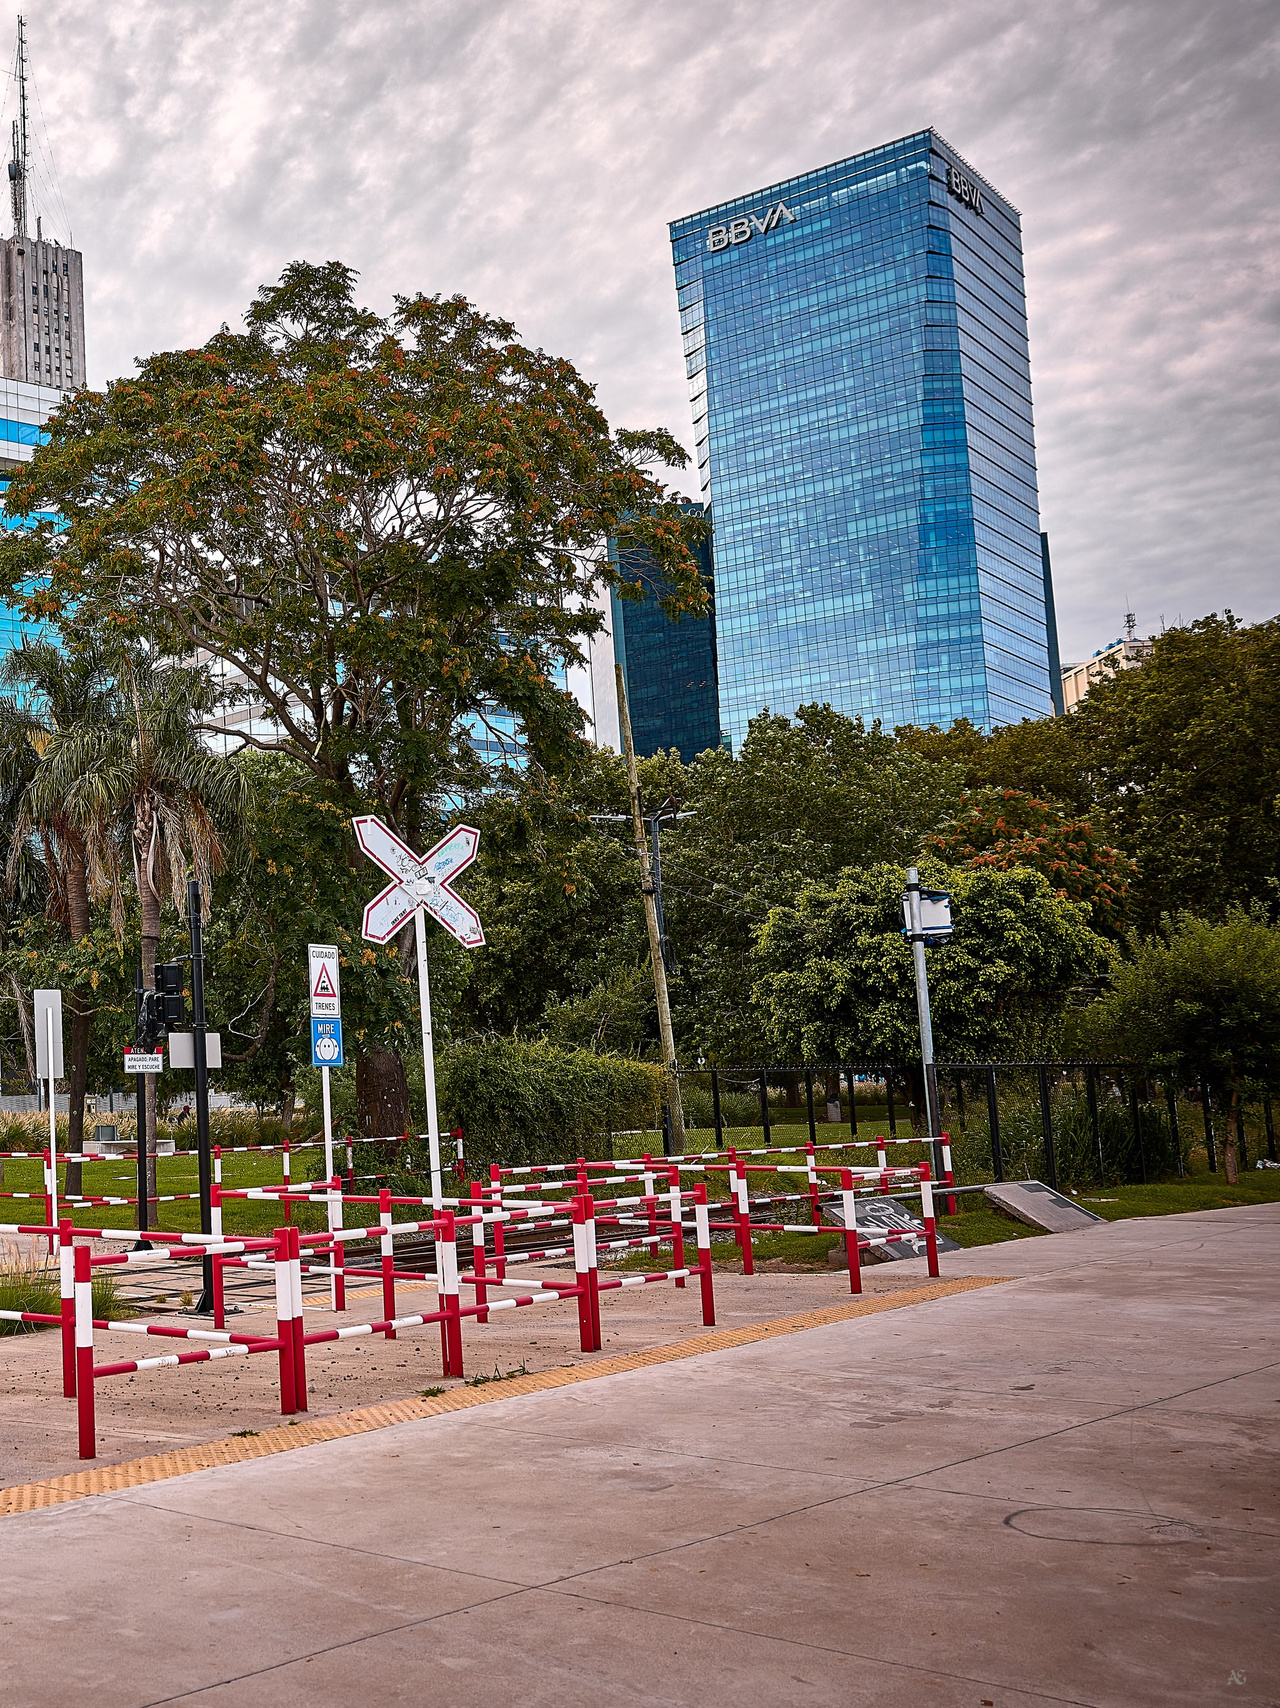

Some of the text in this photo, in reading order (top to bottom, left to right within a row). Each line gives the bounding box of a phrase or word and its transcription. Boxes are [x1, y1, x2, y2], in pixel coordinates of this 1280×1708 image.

[951, 166, 985, 214] BBVA
[708, 202, 795, 252] BBVA
[312, 950, 335, 959] CUIDADO
[315, 1002, 336, 1011] TRENES
[317, 1023, 335, 1034] MIRE
